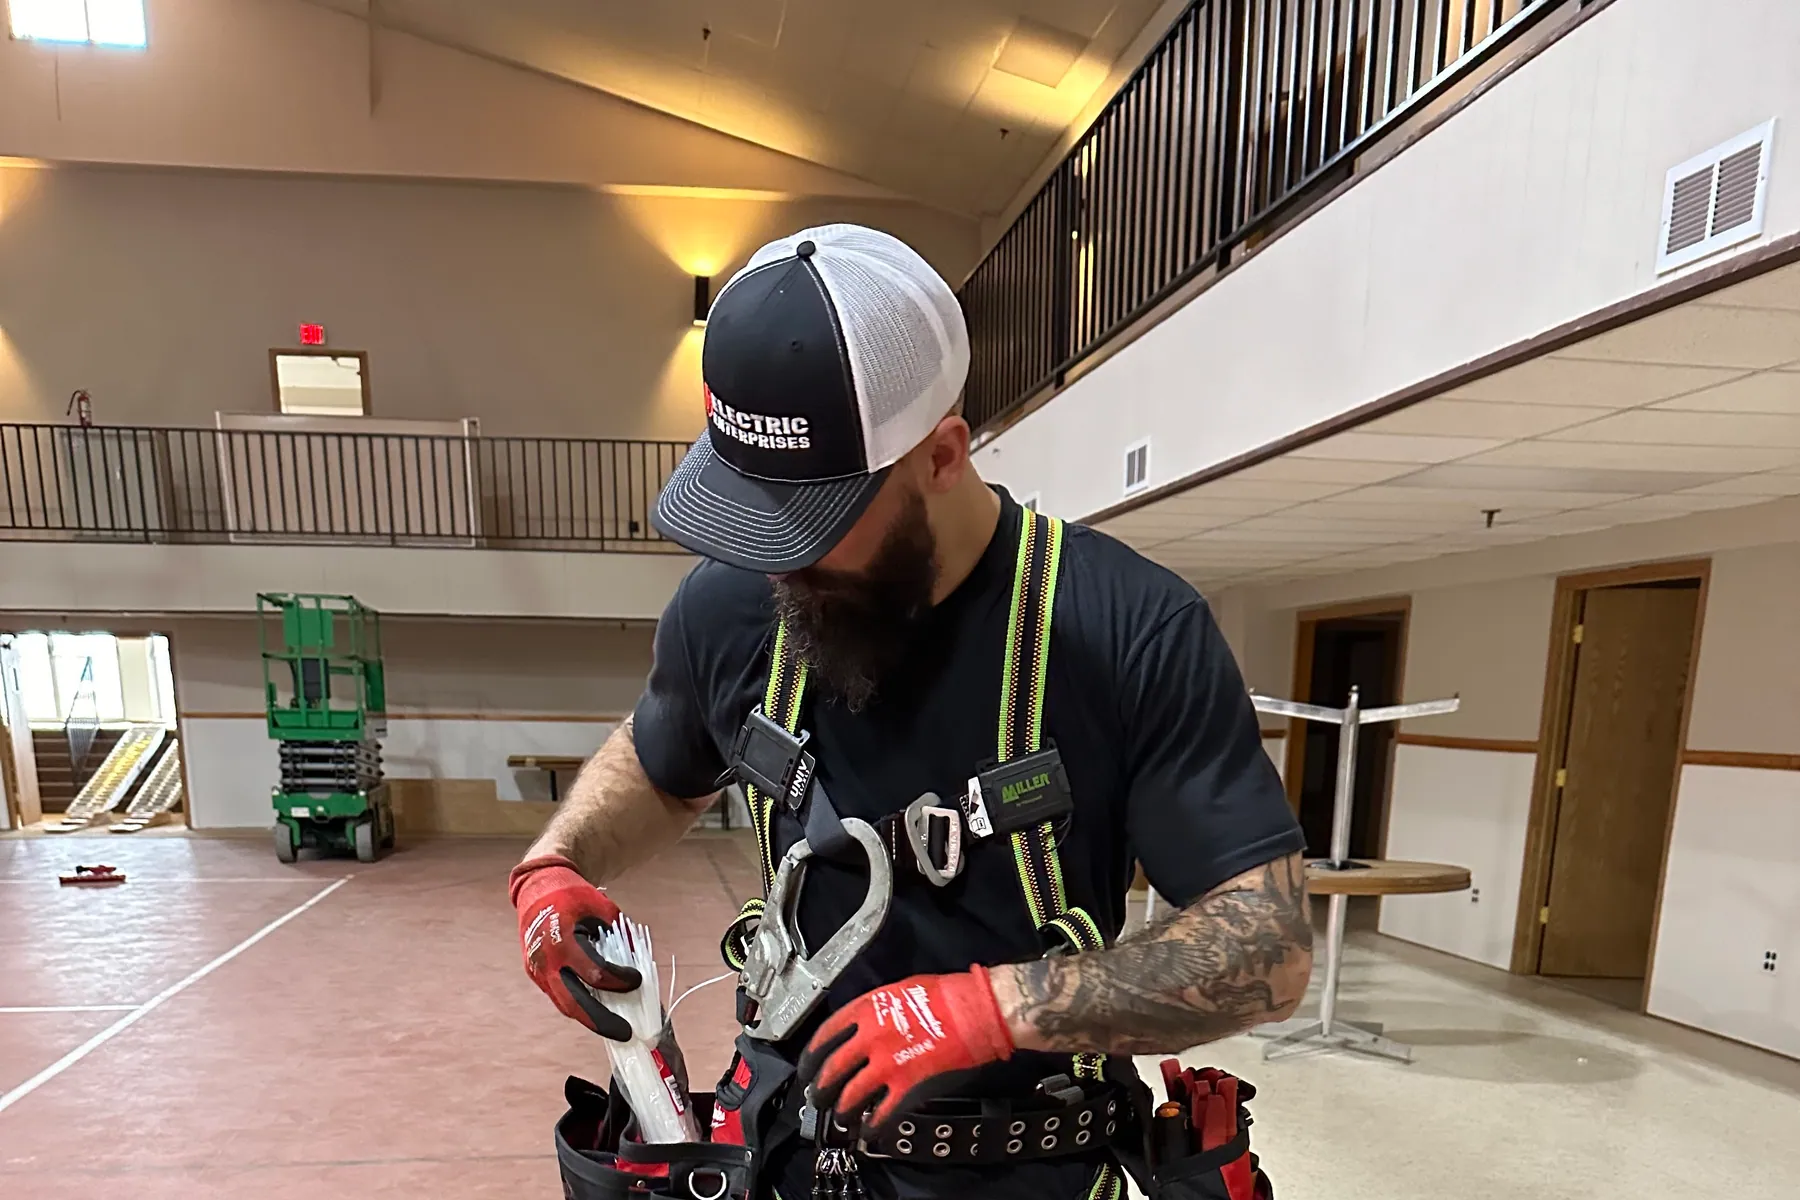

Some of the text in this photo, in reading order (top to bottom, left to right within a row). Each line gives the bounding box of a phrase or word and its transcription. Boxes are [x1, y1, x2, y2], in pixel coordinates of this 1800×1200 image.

[300, 324, 323, 345] EXIT
[711, 393, 809, 435] ELECTRIC
[713, 413, 810, 449] ENTERPRISES
[1001, 772, 1051, 805] MILLER
